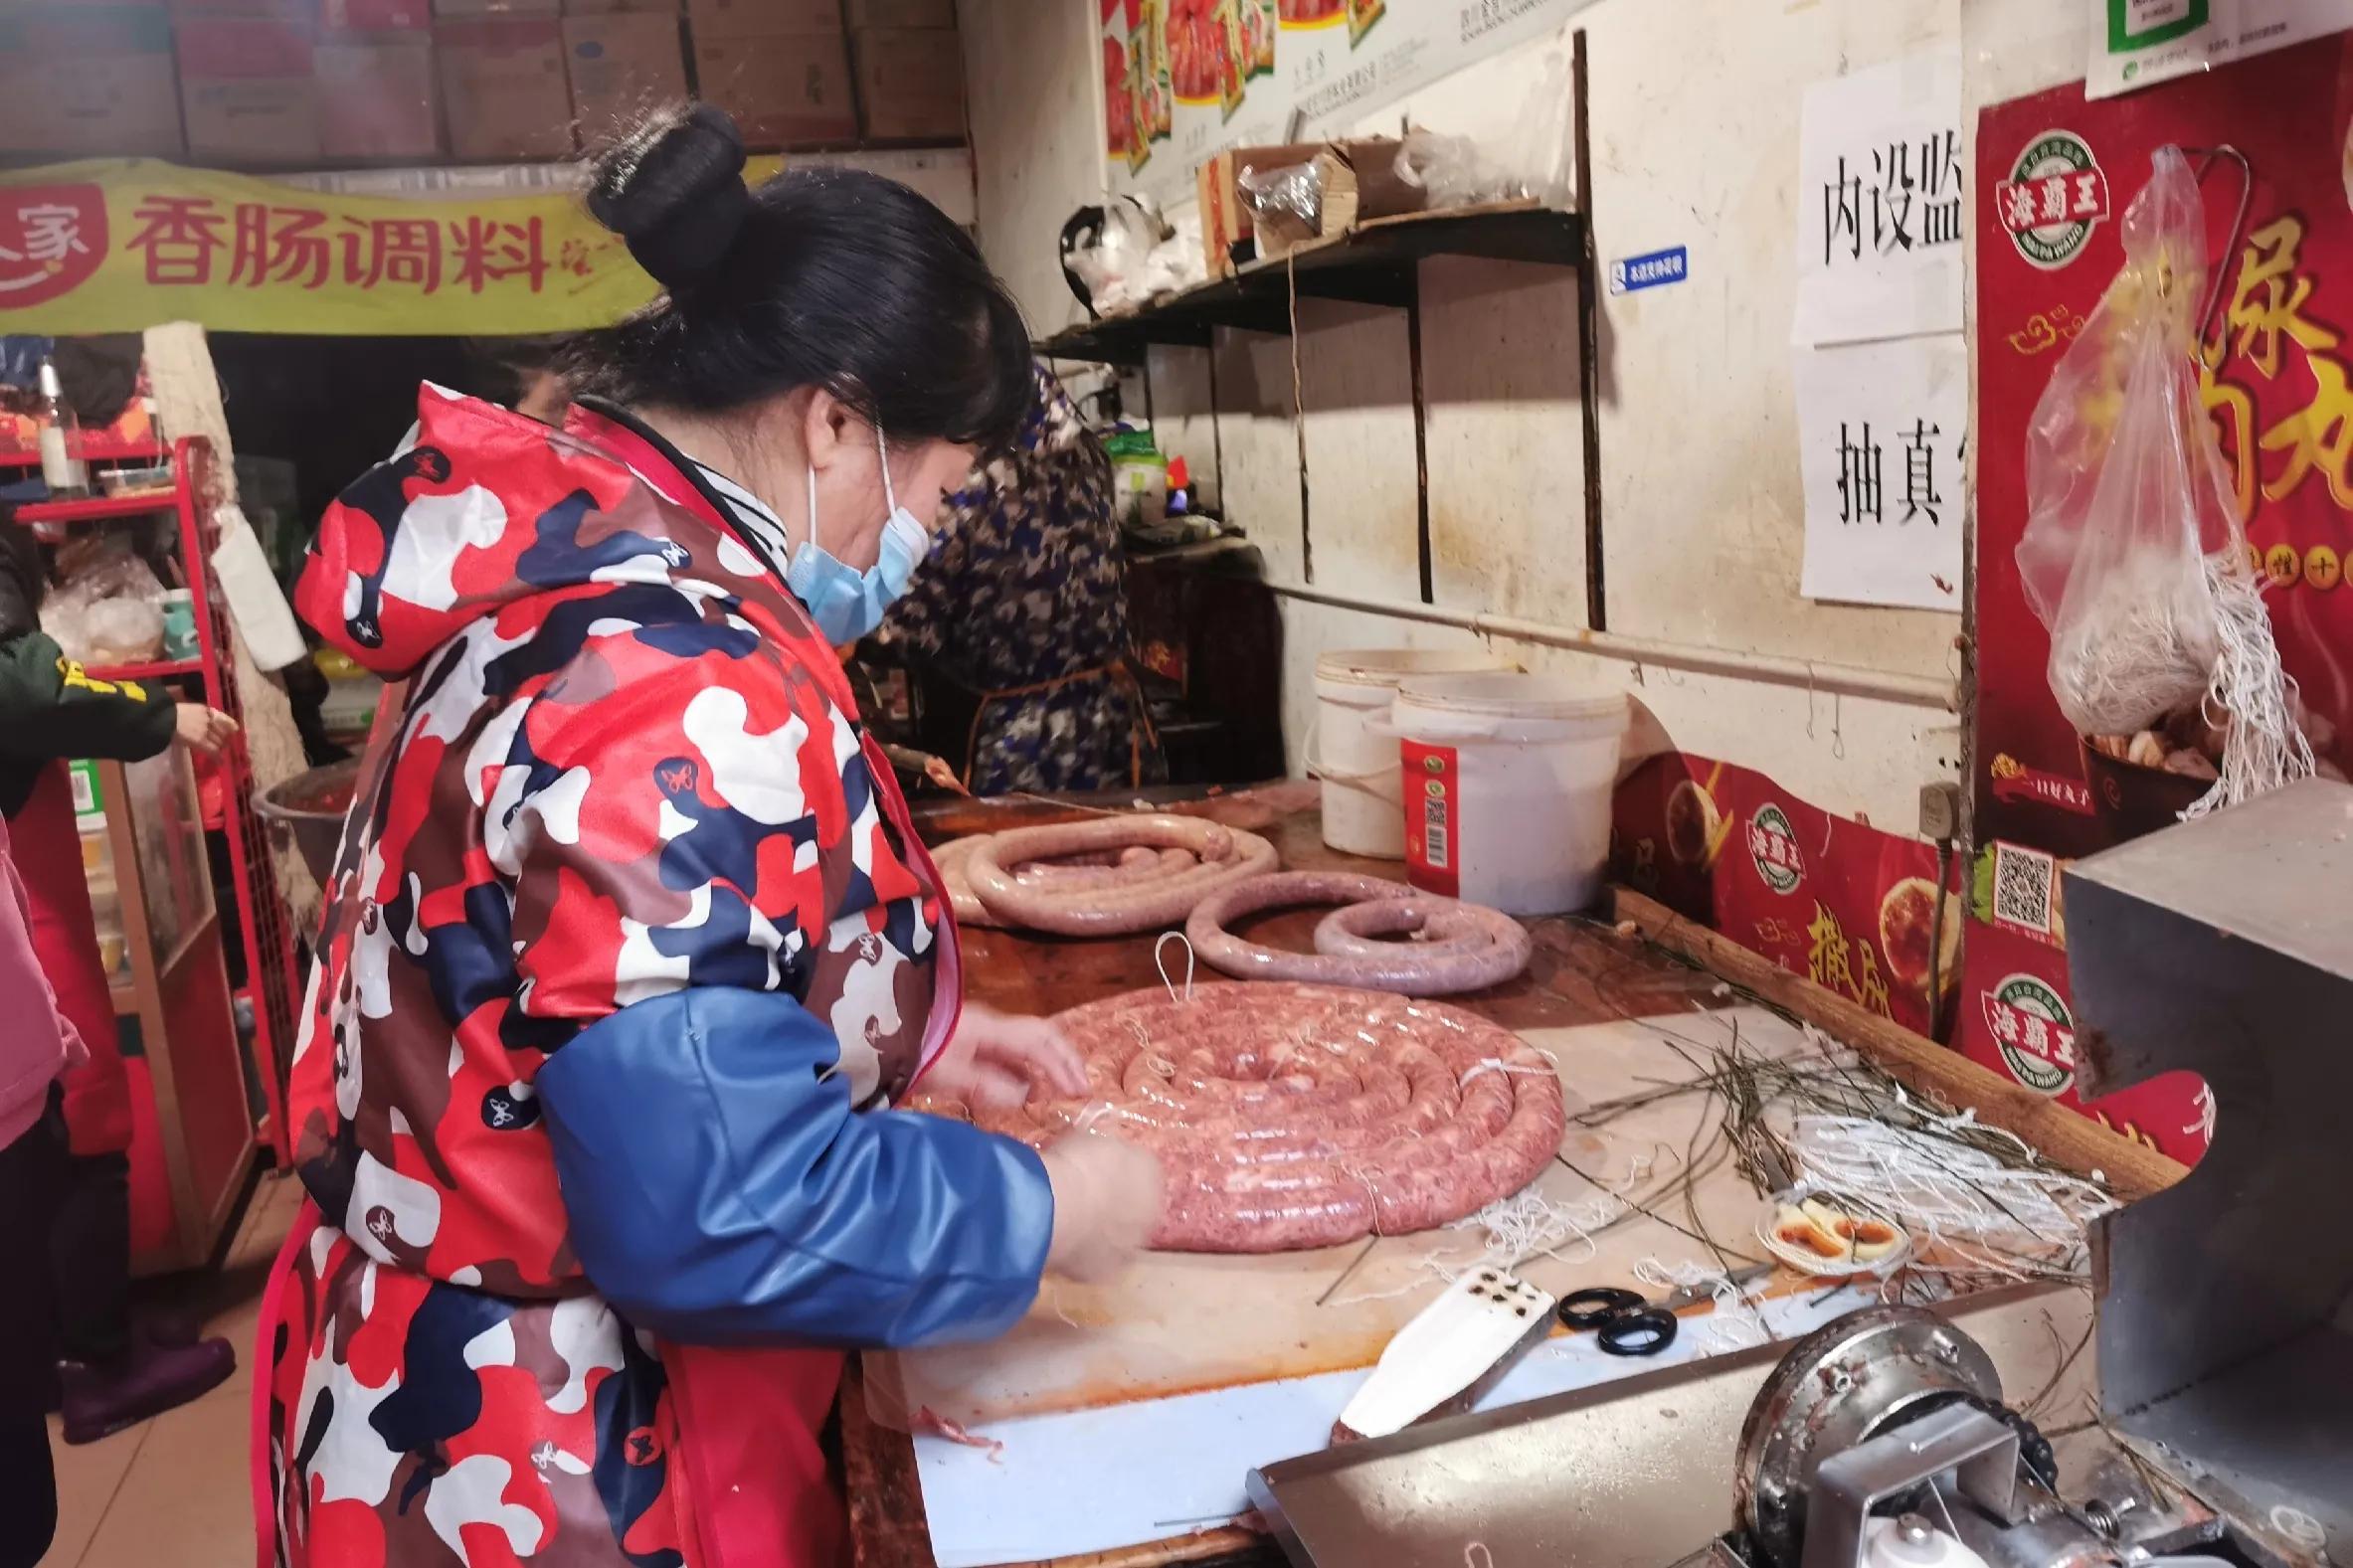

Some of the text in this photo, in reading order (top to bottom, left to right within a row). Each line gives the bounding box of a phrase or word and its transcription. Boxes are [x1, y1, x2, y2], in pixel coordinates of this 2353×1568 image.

[2006, 172, 2098, 228] 海霸王
[125, 195, 550, 295] 香肠调料
